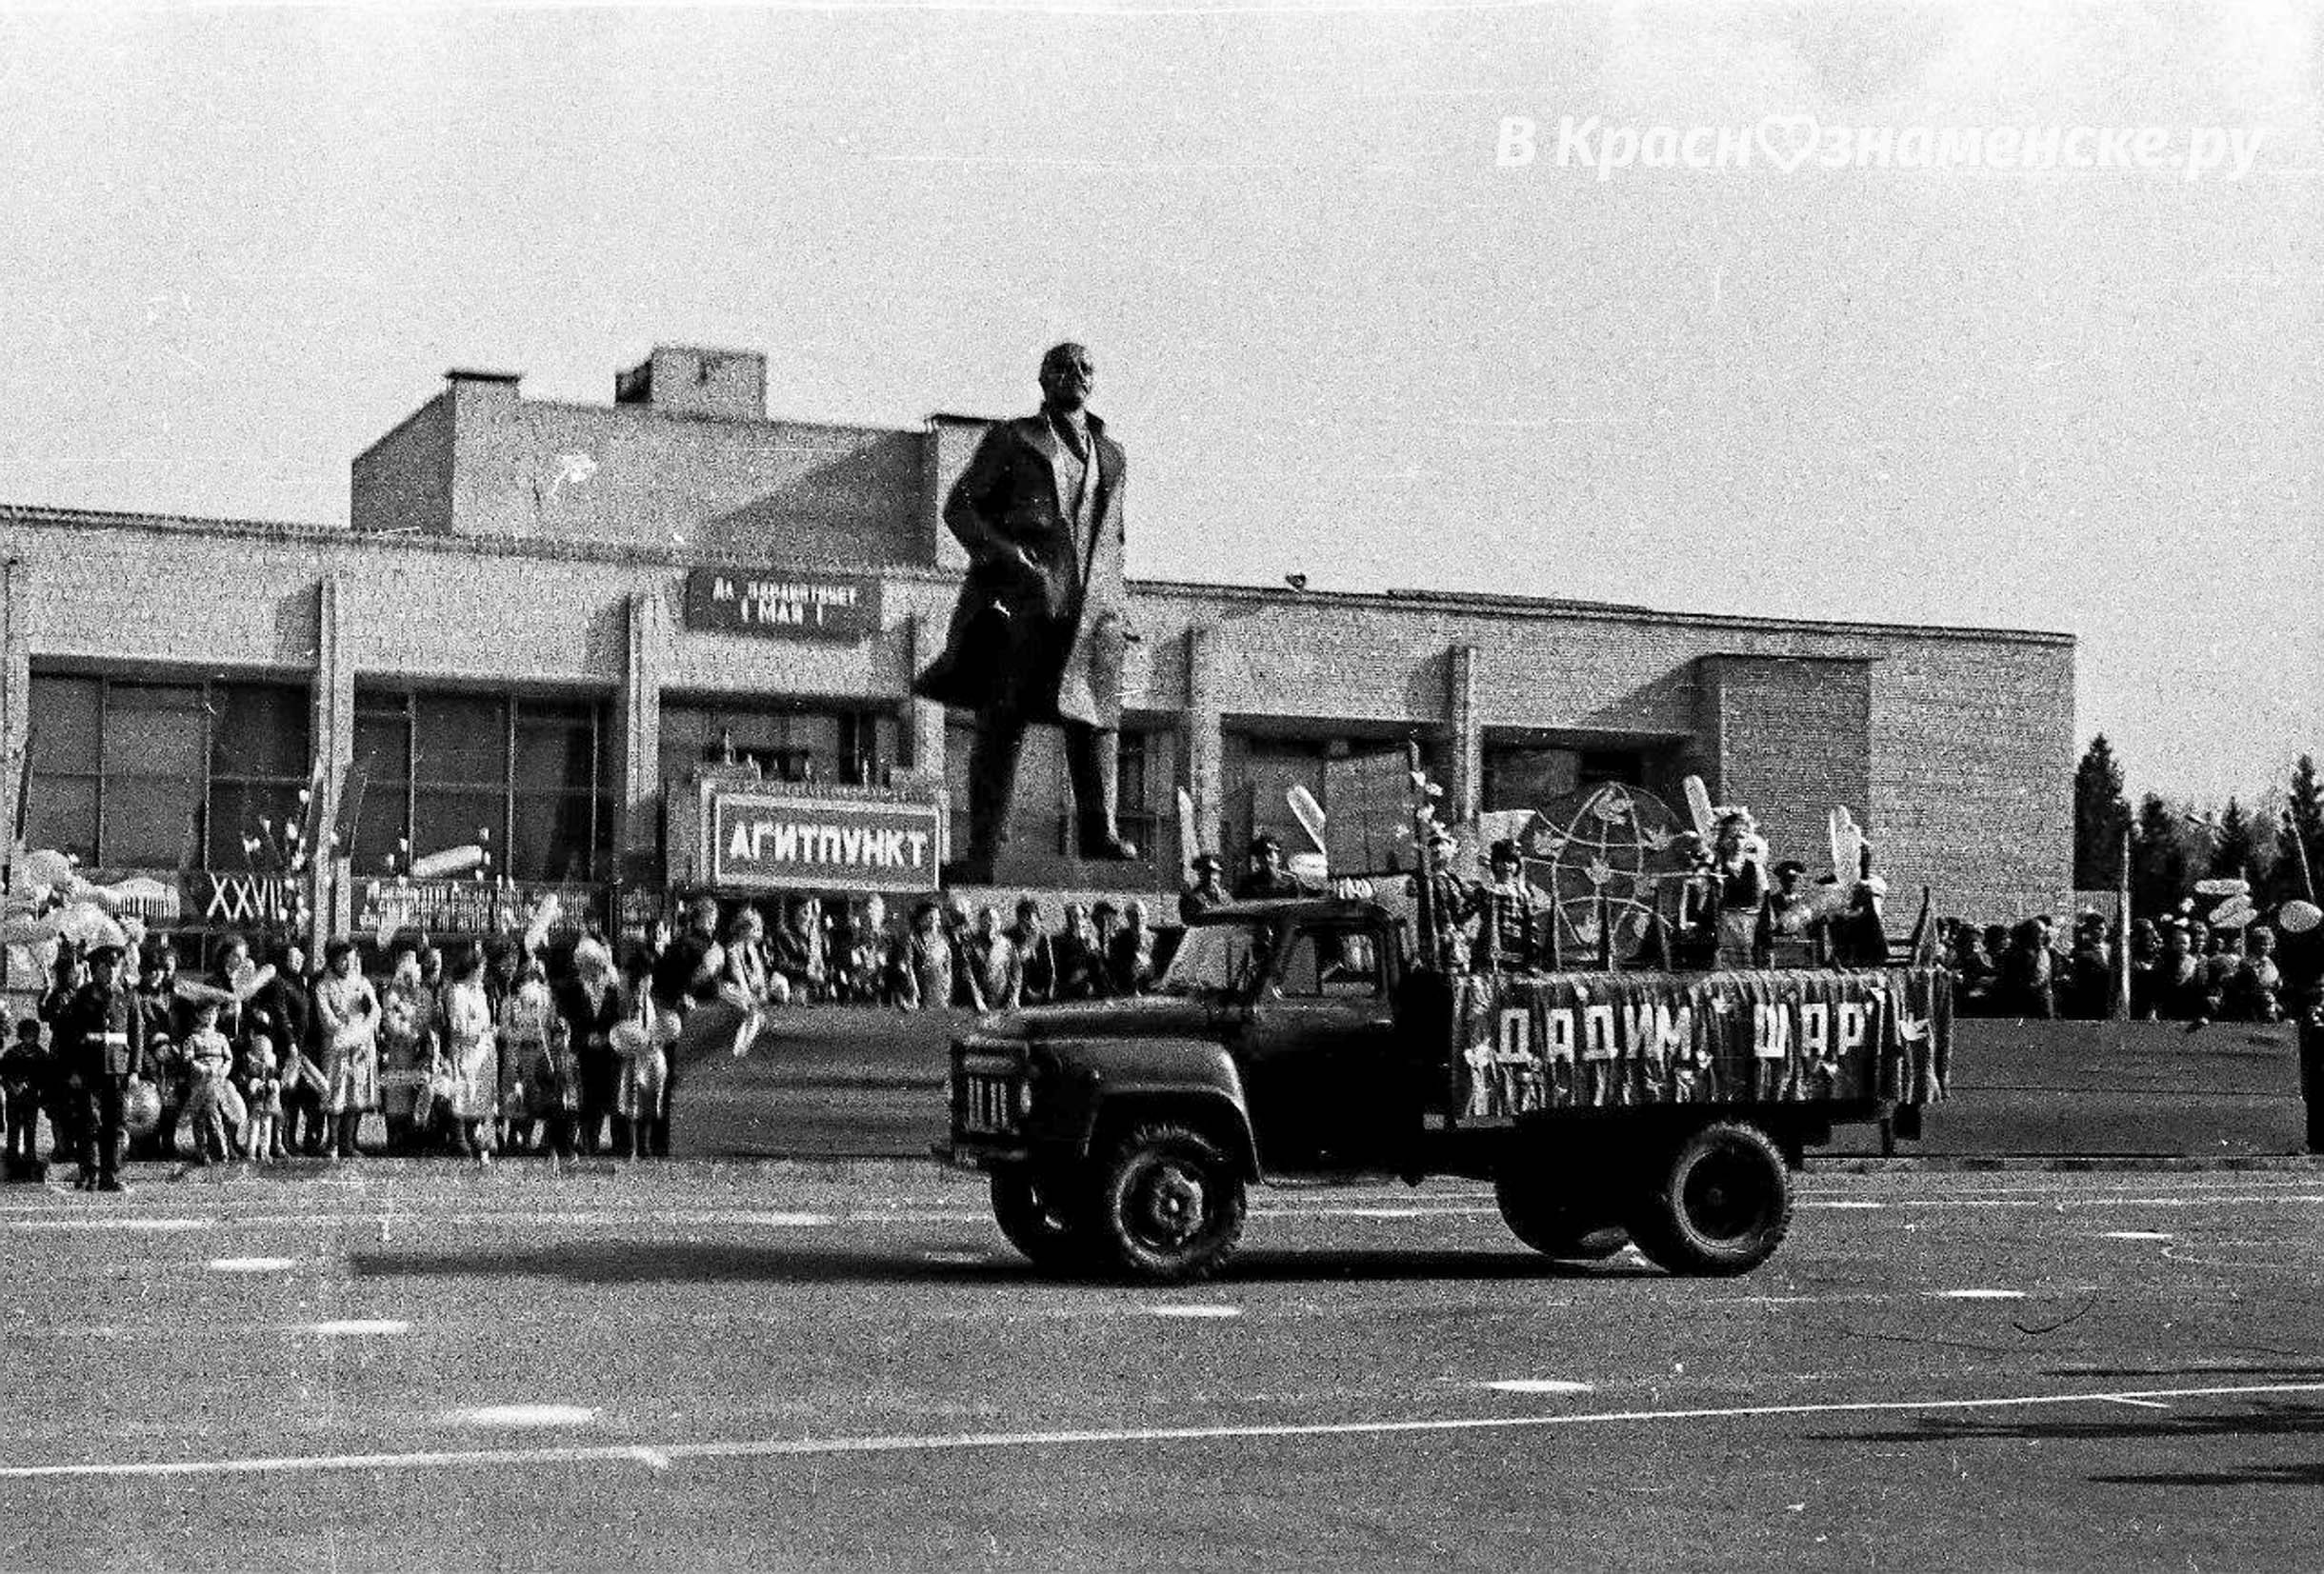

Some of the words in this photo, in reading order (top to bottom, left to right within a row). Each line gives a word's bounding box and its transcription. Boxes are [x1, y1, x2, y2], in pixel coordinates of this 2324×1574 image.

[729, 820, 929, 867] АГИТПУНКТ
[1495, 1003, 1693, 1064] ДАДИМ
[1753, 1003, 1866, 1058] ШАР
